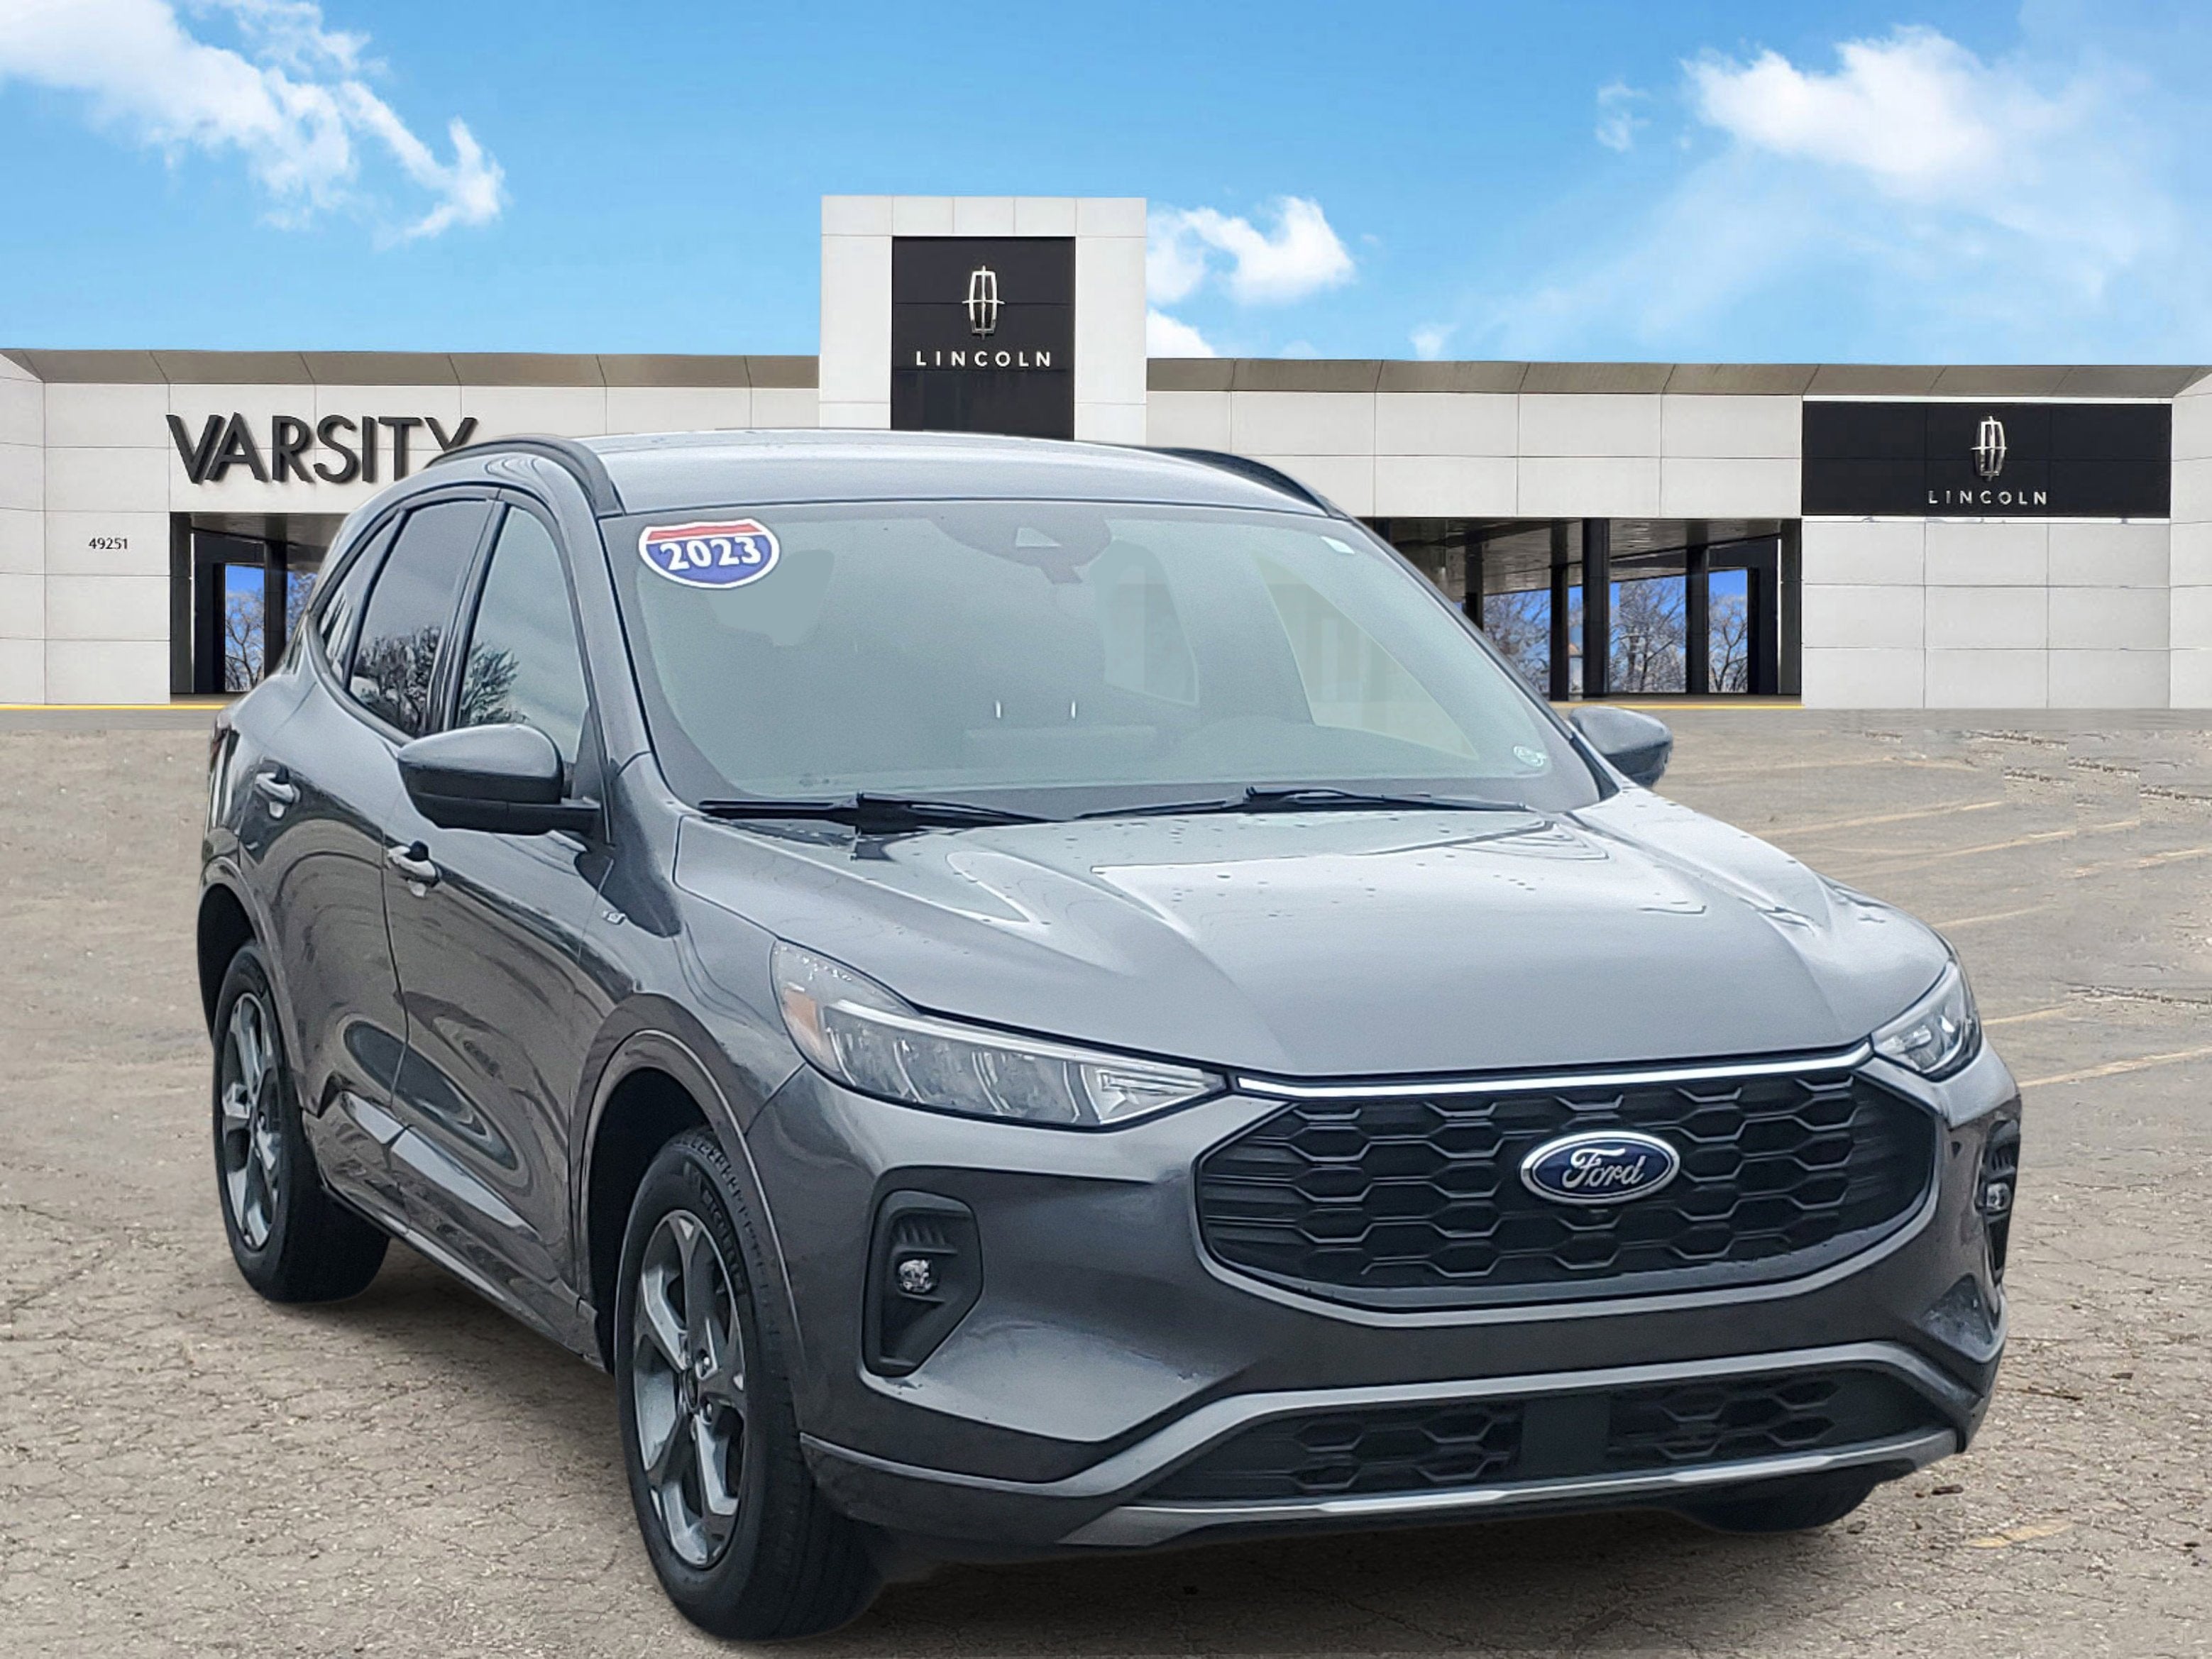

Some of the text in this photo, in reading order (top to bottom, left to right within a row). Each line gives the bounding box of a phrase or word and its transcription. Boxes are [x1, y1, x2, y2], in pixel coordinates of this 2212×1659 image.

[915, 350, 1051, 368] LINCOLN
[165, 412, 478, 484] VARSITY
[1927, 490, 2047, 505] LINCOLN
[88, 537, 129, 550] 49251
[659, 536, 762, 571] 2023
[1561, 1147, 1646, 1189] Ford
